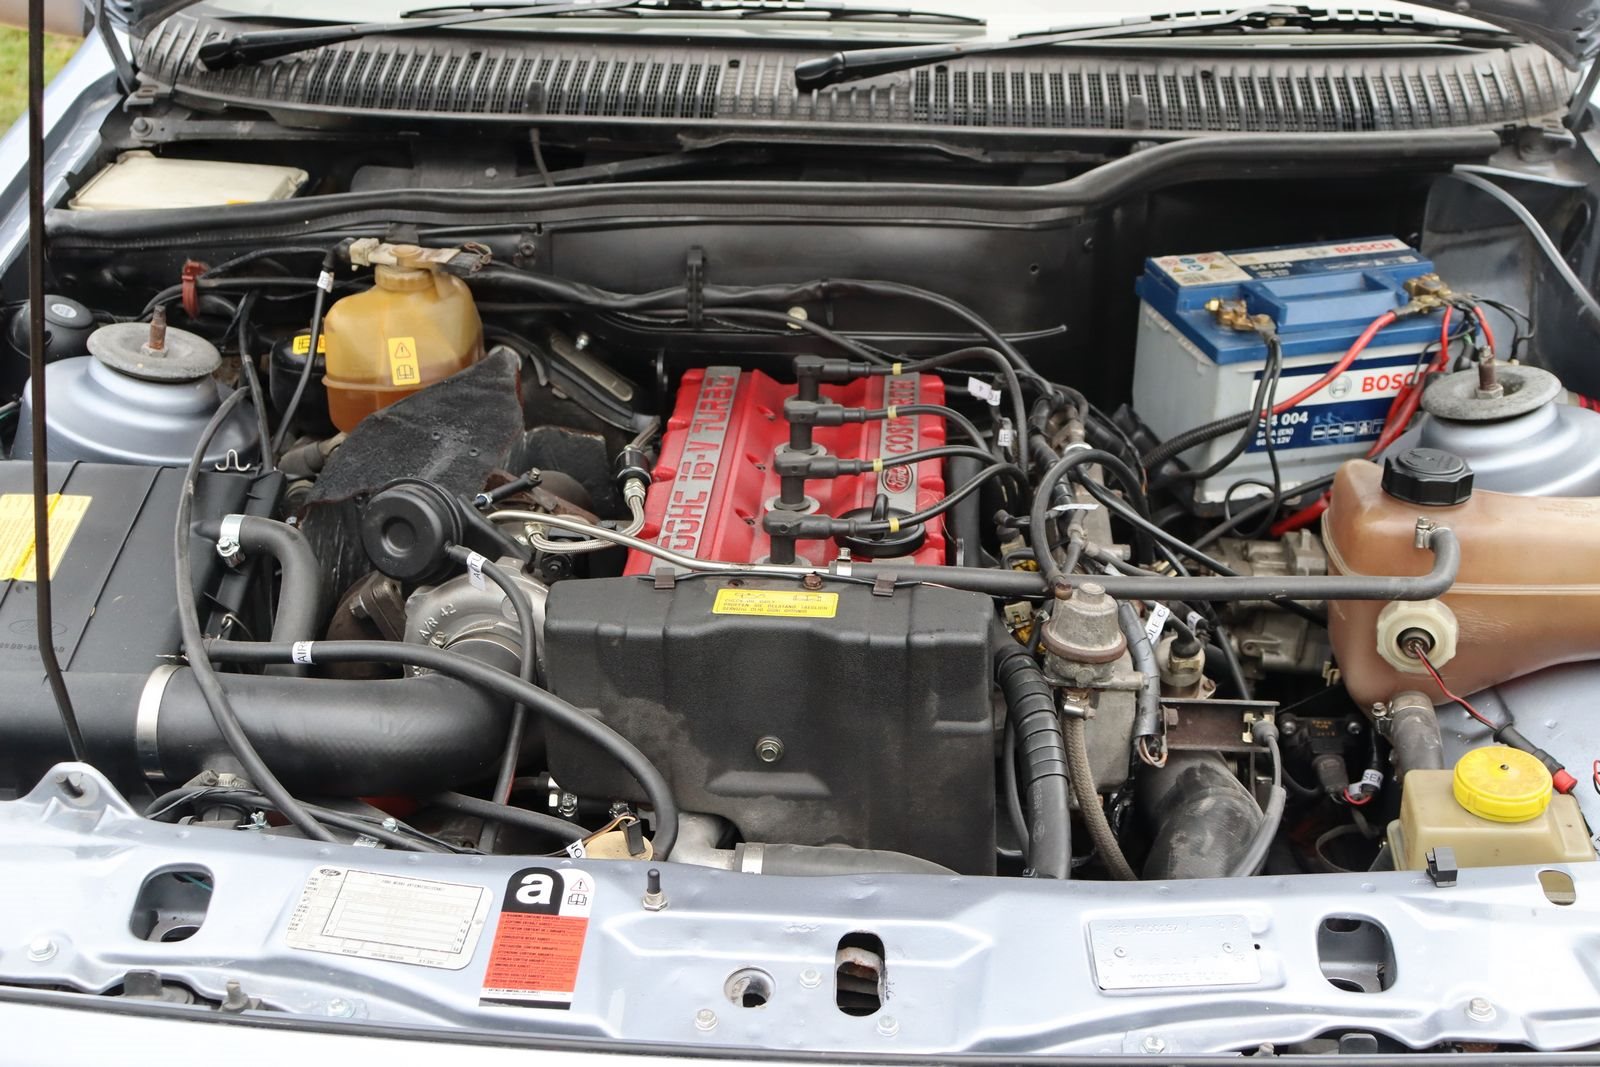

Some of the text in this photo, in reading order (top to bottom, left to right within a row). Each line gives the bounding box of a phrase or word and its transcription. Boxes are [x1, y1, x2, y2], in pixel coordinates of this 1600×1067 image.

[1334, 242, 1396, 254] BOSCH
[1362, 372, 1425, 393] BOSC
[886, 381, 915, 454] COSWRTH
[1281, 411, 1309, 426] 004
[662, 491, 708, 551] DOHC
[692, 375, 735, 434] TURBO
[418, 616, 439, 639] A/R
[516, 873, 555, 905] a
